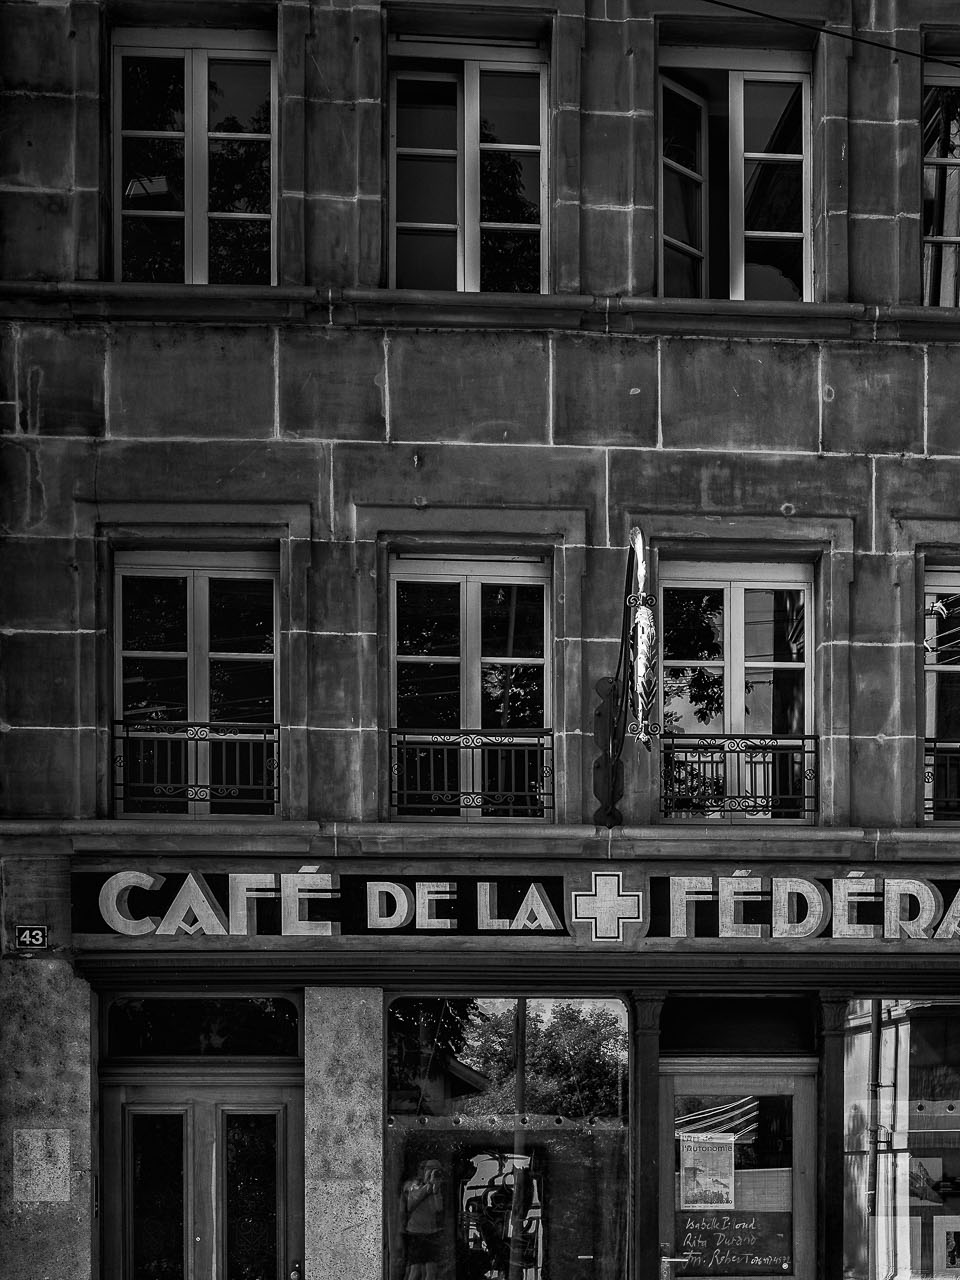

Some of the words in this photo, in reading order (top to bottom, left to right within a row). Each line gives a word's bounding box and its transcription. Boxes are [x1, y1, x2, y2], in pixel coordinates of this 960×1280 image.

[99, 866, 338, 937] CAFÉ
[367, 881, 457, 930] DE
[477, 882, 563, 931] LA
[19, 929, 44, 946] 43
[682, 1232, 707, 1248] Rita
[713, 1232, 757, 1246] Durand
